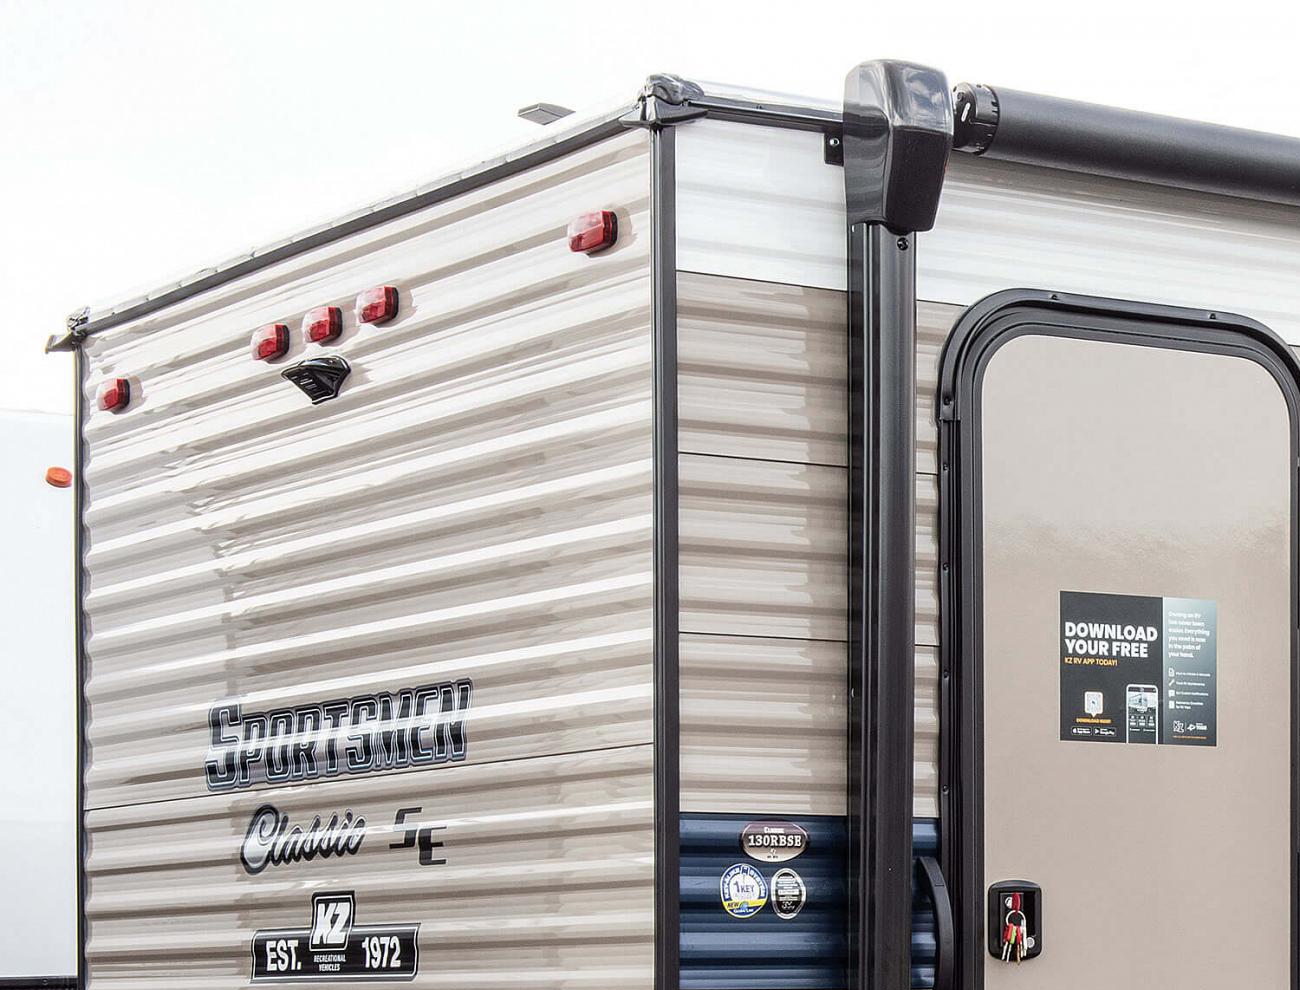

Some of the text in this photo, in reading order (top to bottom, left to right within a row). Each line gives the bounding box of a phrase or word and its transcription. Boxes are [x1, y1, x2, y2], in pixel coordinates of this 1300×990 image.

[1064, 621, 1158, 642] DOWNLOAD
[1065, 638, 1149, 658] YOUR FREE
[205, 677, 474, 792] SPORTSMEN
[240, 803, 367, 875] Classic
[748, 834, 802, 848] 130RBSE
[740, 884, 754, 893] KEY
[312, 901, 351, 945] KZ
[266, 936, 401, 972] EST. 1972
[313, 953, 347, 964] RECREATIONAL
[318, 962, 341, 972] VEHICLES
